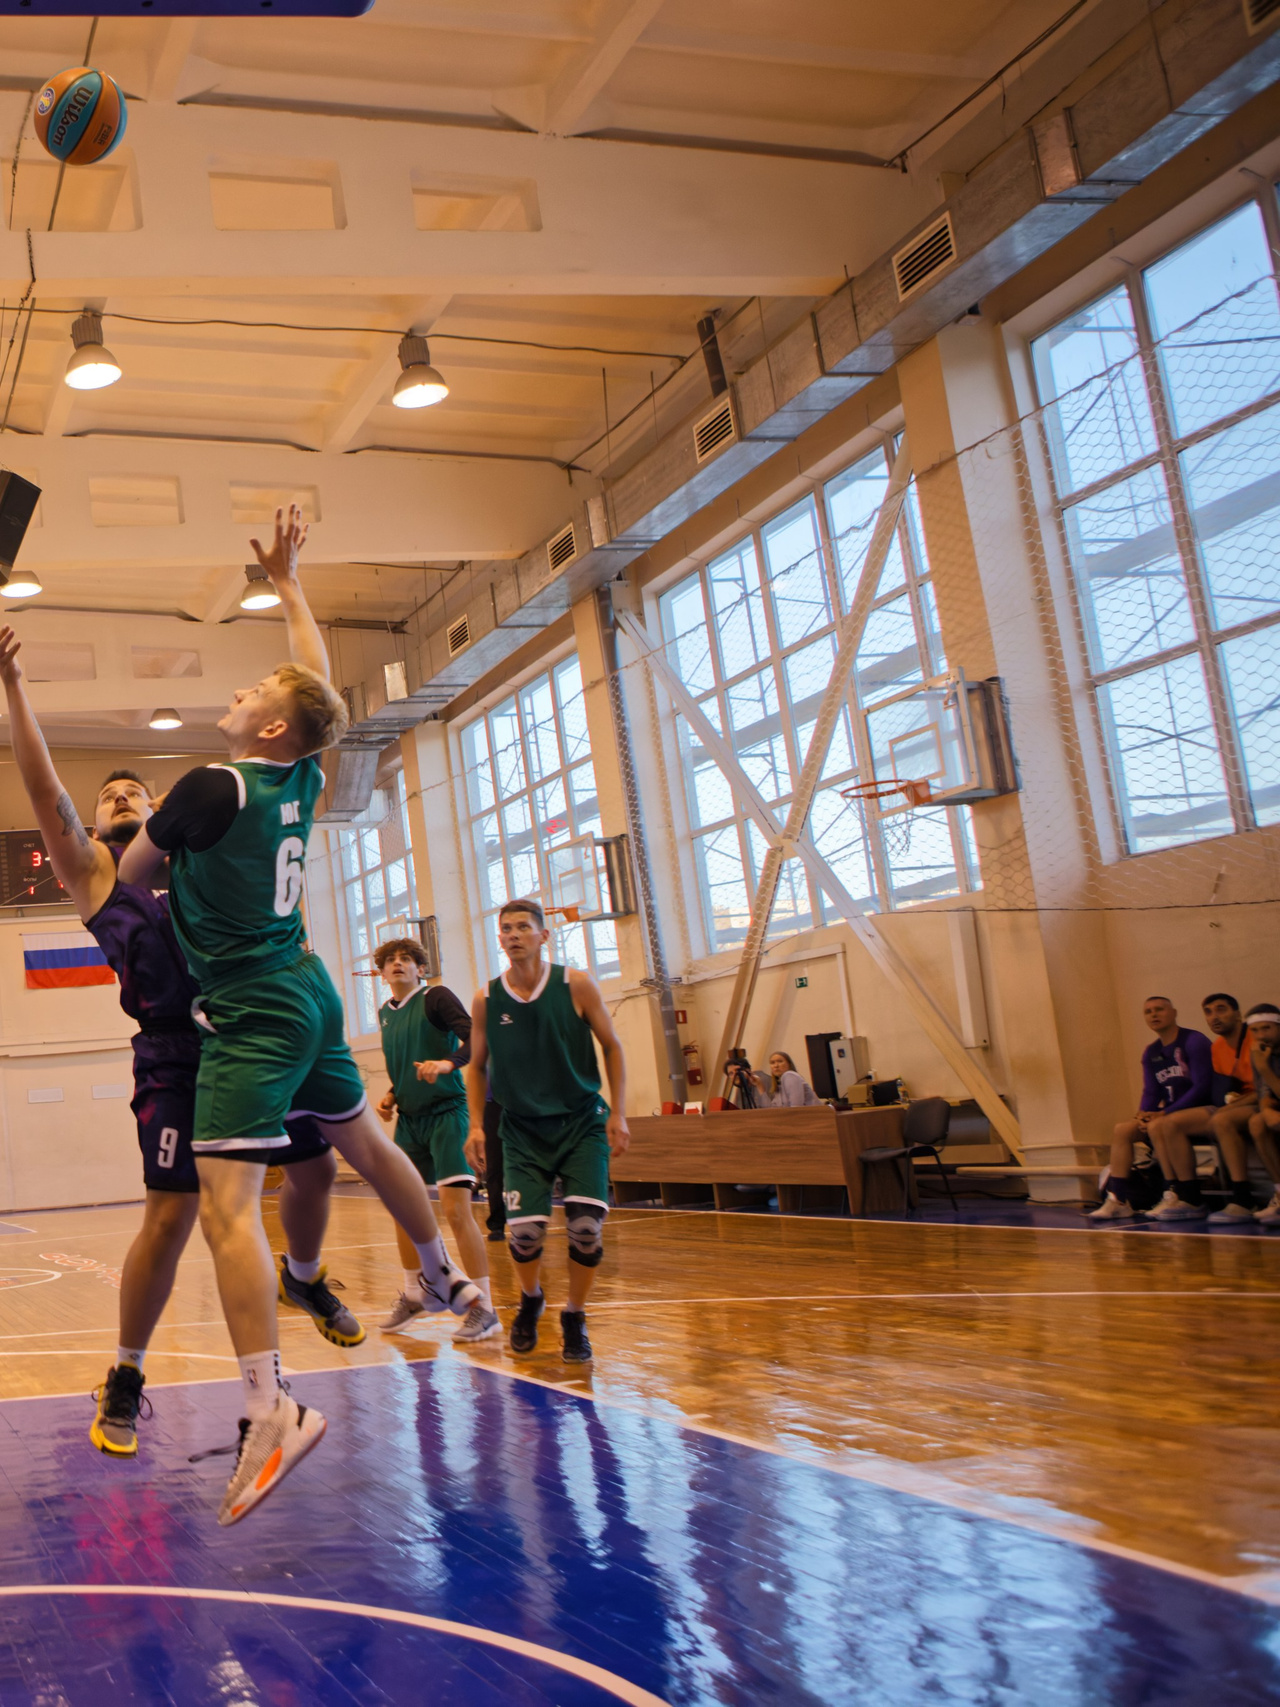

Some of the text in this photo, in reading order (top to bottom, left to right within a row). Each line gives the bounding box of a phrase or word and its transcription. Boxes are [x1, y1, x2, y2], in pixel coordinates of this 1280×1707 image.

[53, 86, 95, 146] Wilson
[32, 851, 42, 867] 3
[274, 836, 304, 917] 6
[157, 1126, 179, 1169] 9
